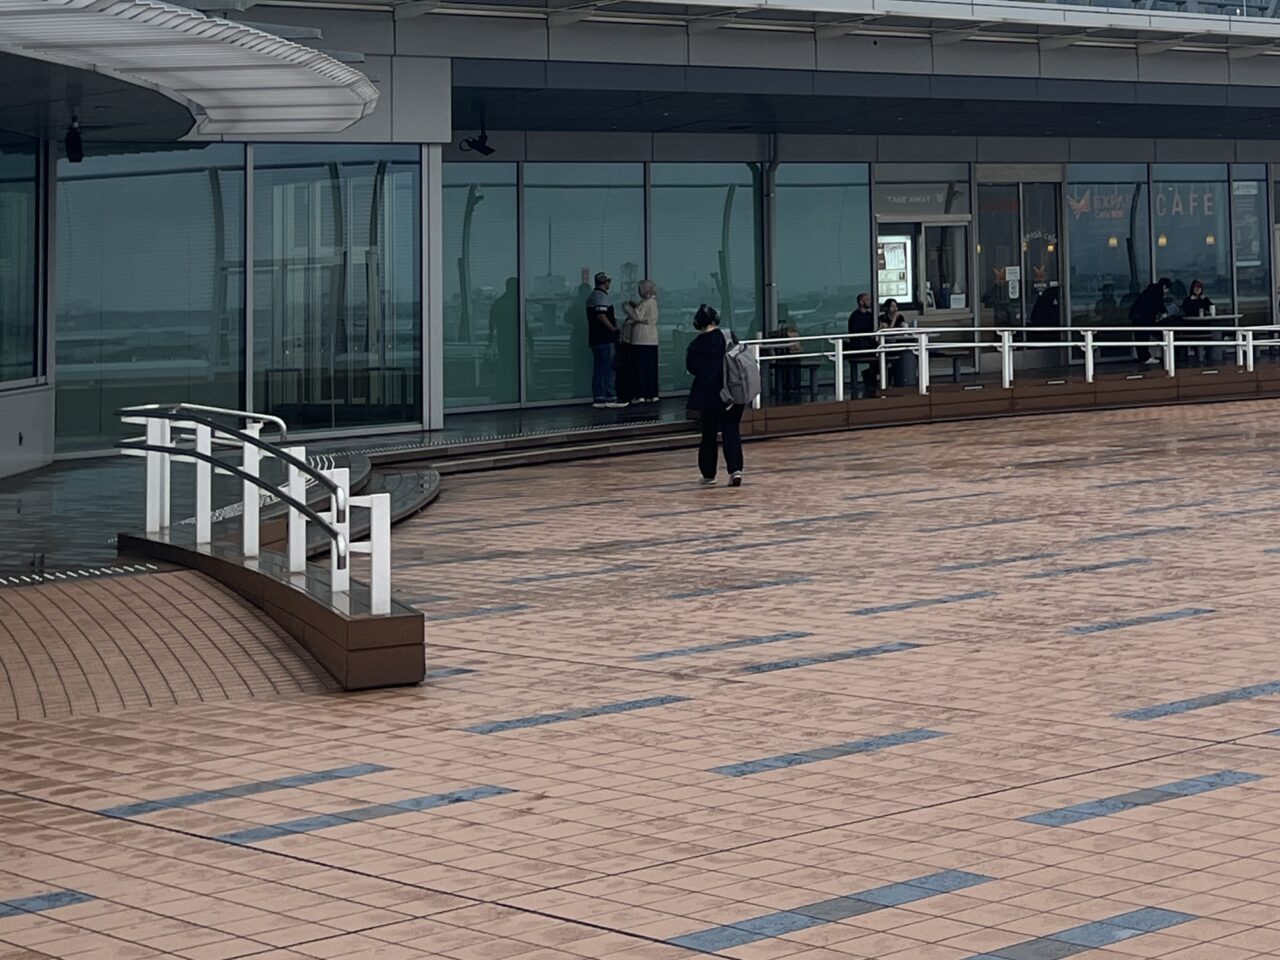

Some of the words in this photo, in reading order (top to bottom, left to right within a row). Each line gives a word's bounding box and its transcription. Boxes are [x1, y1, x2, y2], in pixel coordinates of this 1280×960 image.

[888, 195, 907, 204] TAKE
[908, 195, 931, 204] AWAY
[1156, 193, 1214, 216] CAFE
